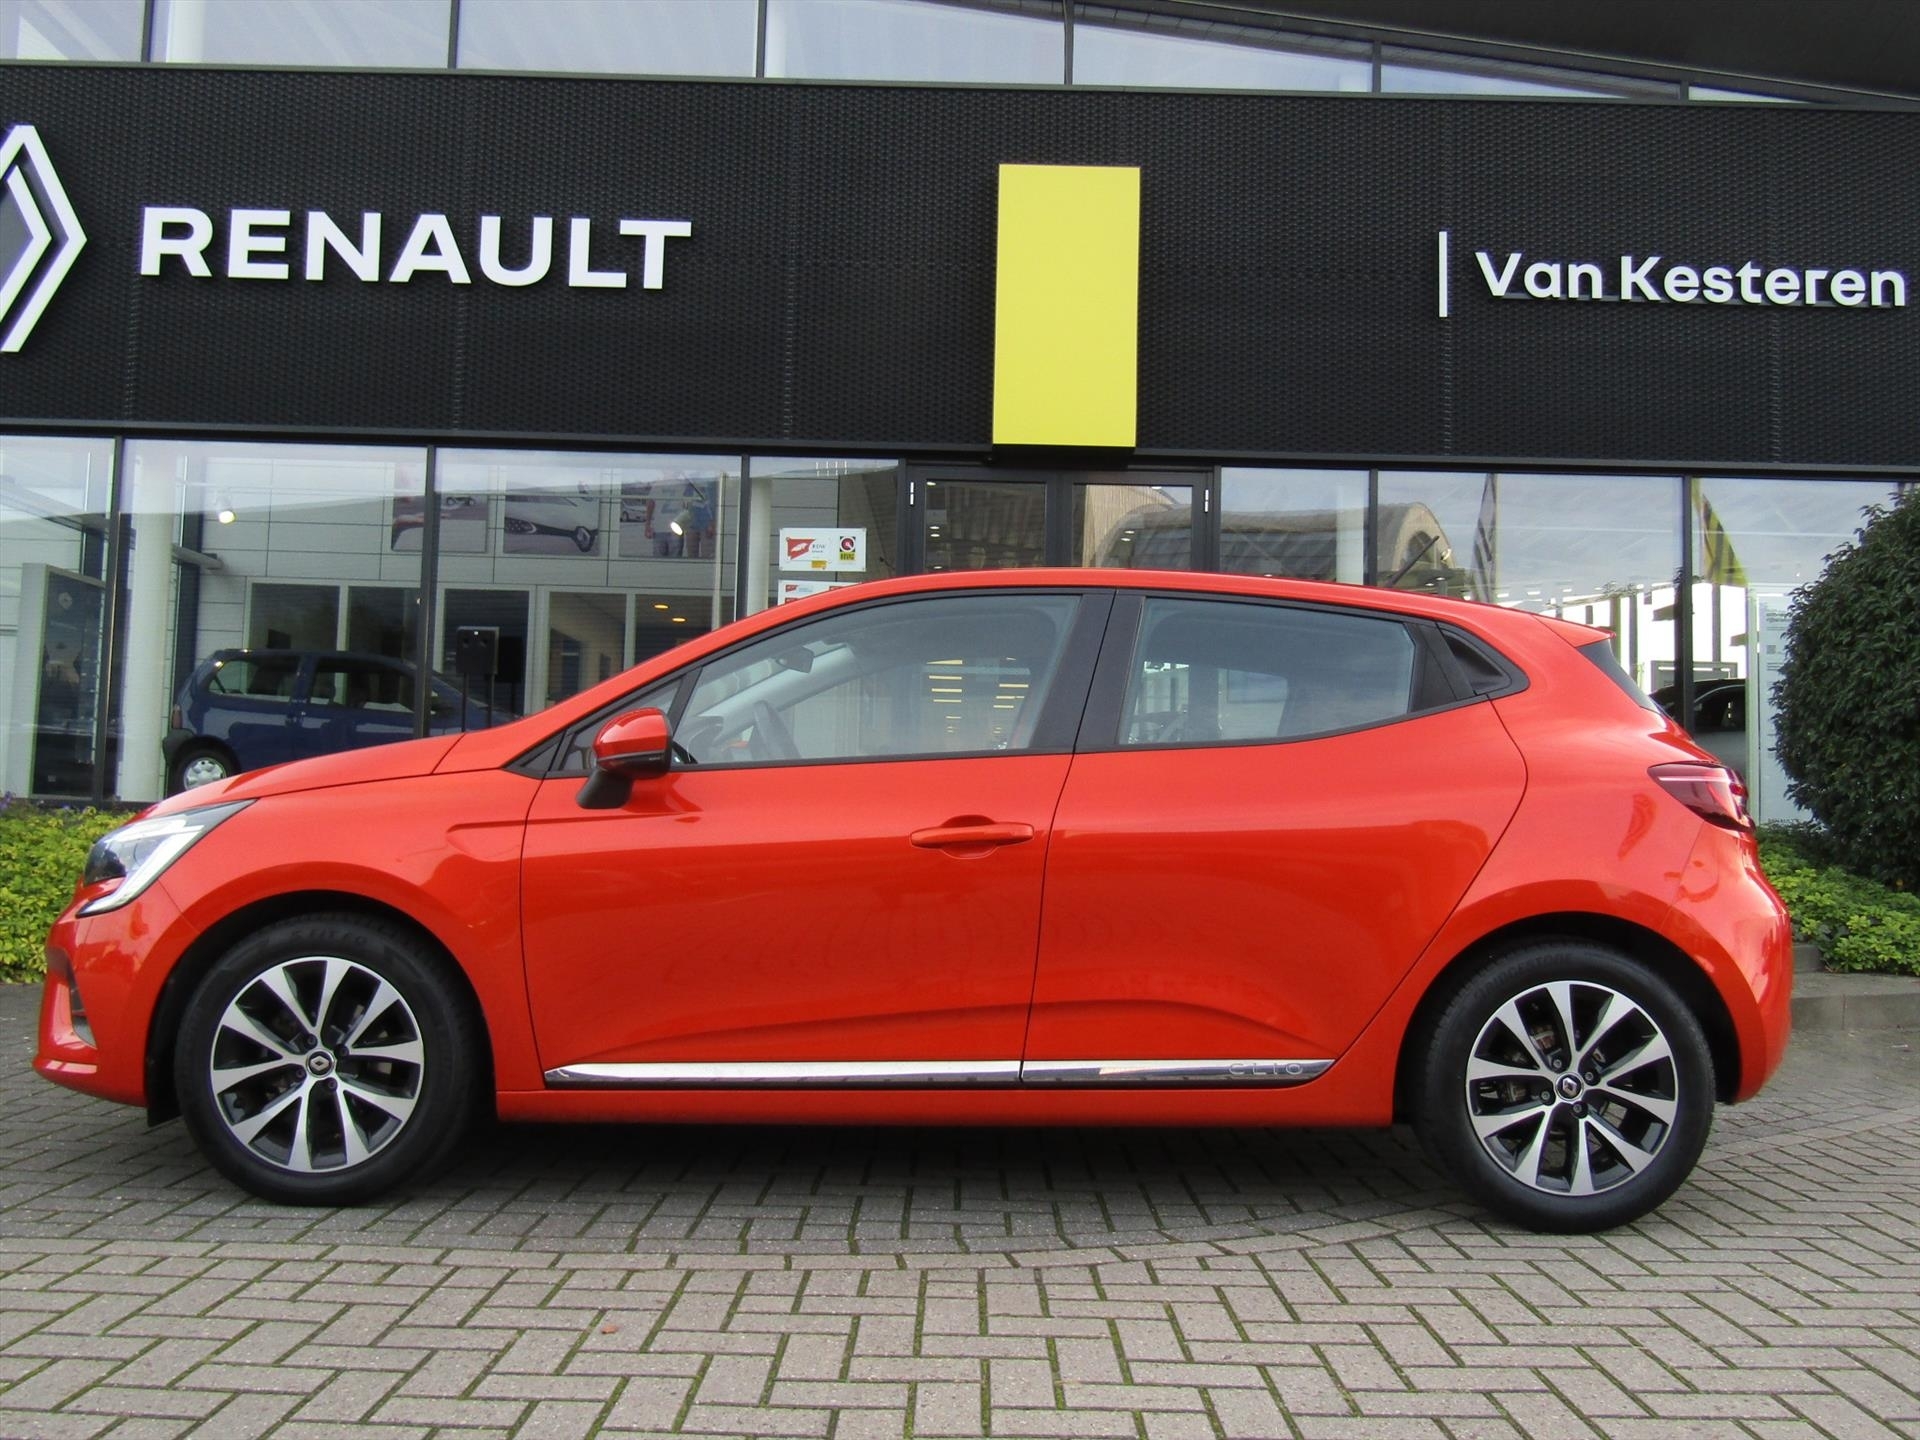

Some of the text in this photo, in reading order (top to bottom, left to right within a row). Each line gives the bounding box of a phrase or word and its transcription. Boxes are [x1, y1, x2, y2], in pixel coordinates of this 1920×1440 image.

[139, 206, 693, 290] RENAULT
[1475, 252, 1906, 307] Van Kesteren
[1229, 1063, 1303, 1075] CLIO
